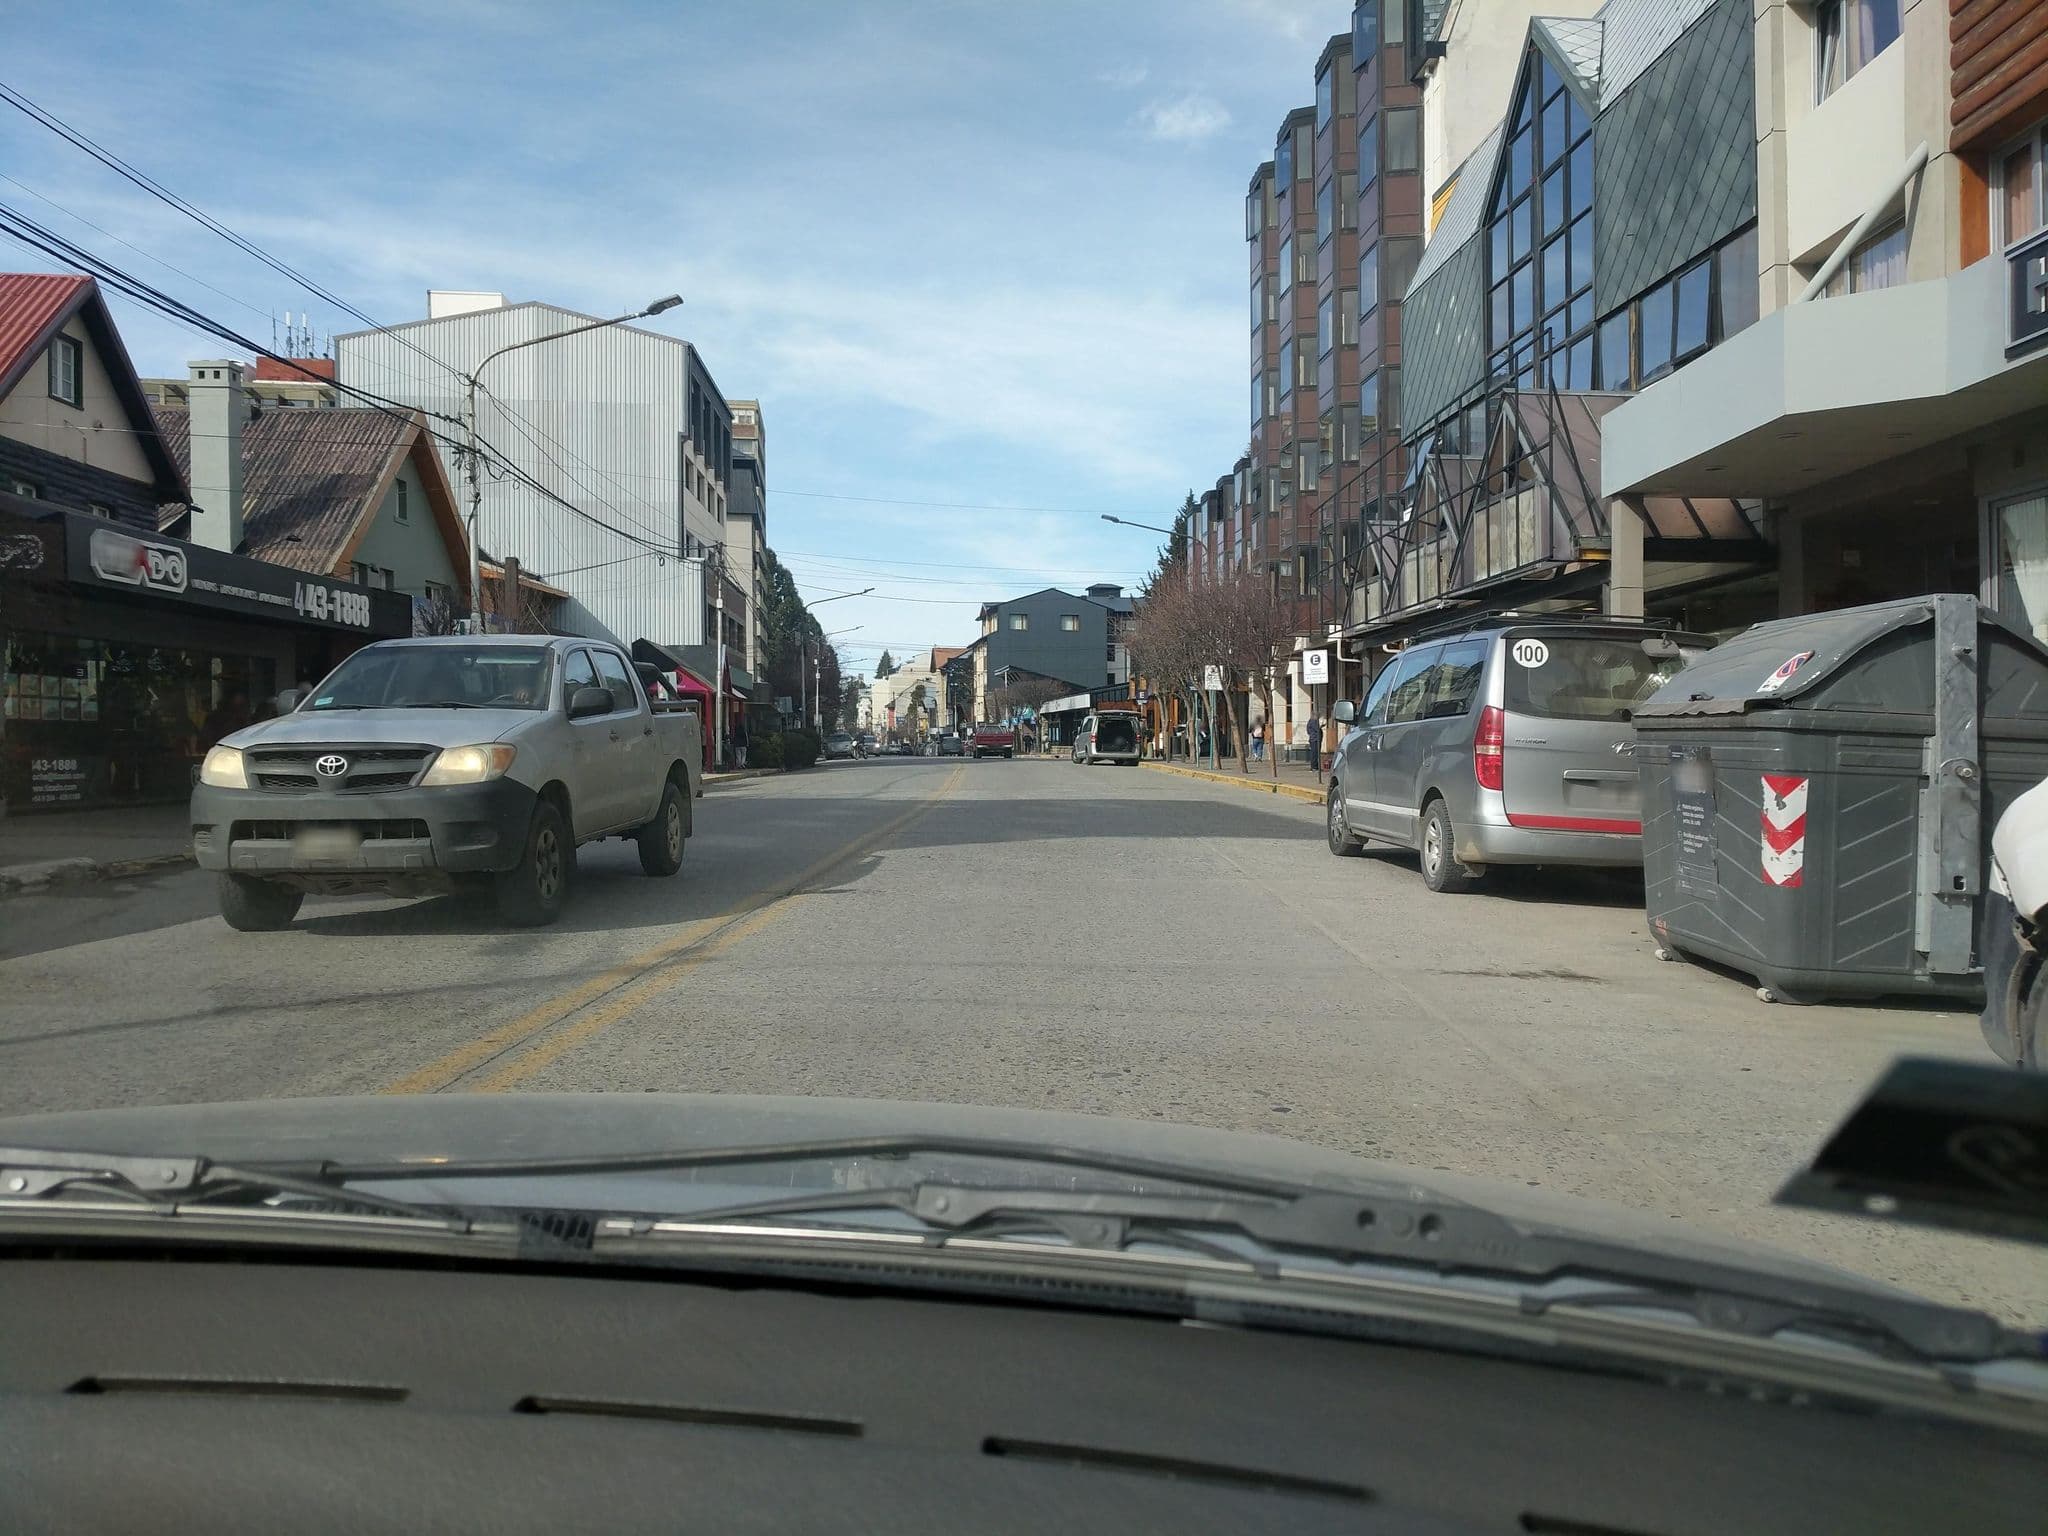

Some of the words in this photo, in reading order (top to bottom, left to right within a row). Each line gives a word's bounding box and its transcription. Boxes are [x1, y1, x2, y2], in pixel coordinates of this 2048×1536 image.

[294, 581, 370, 628] 443-1888
[1516, 644, 1544, 663] 100
[32, 759, 78, 771] 43-1888
